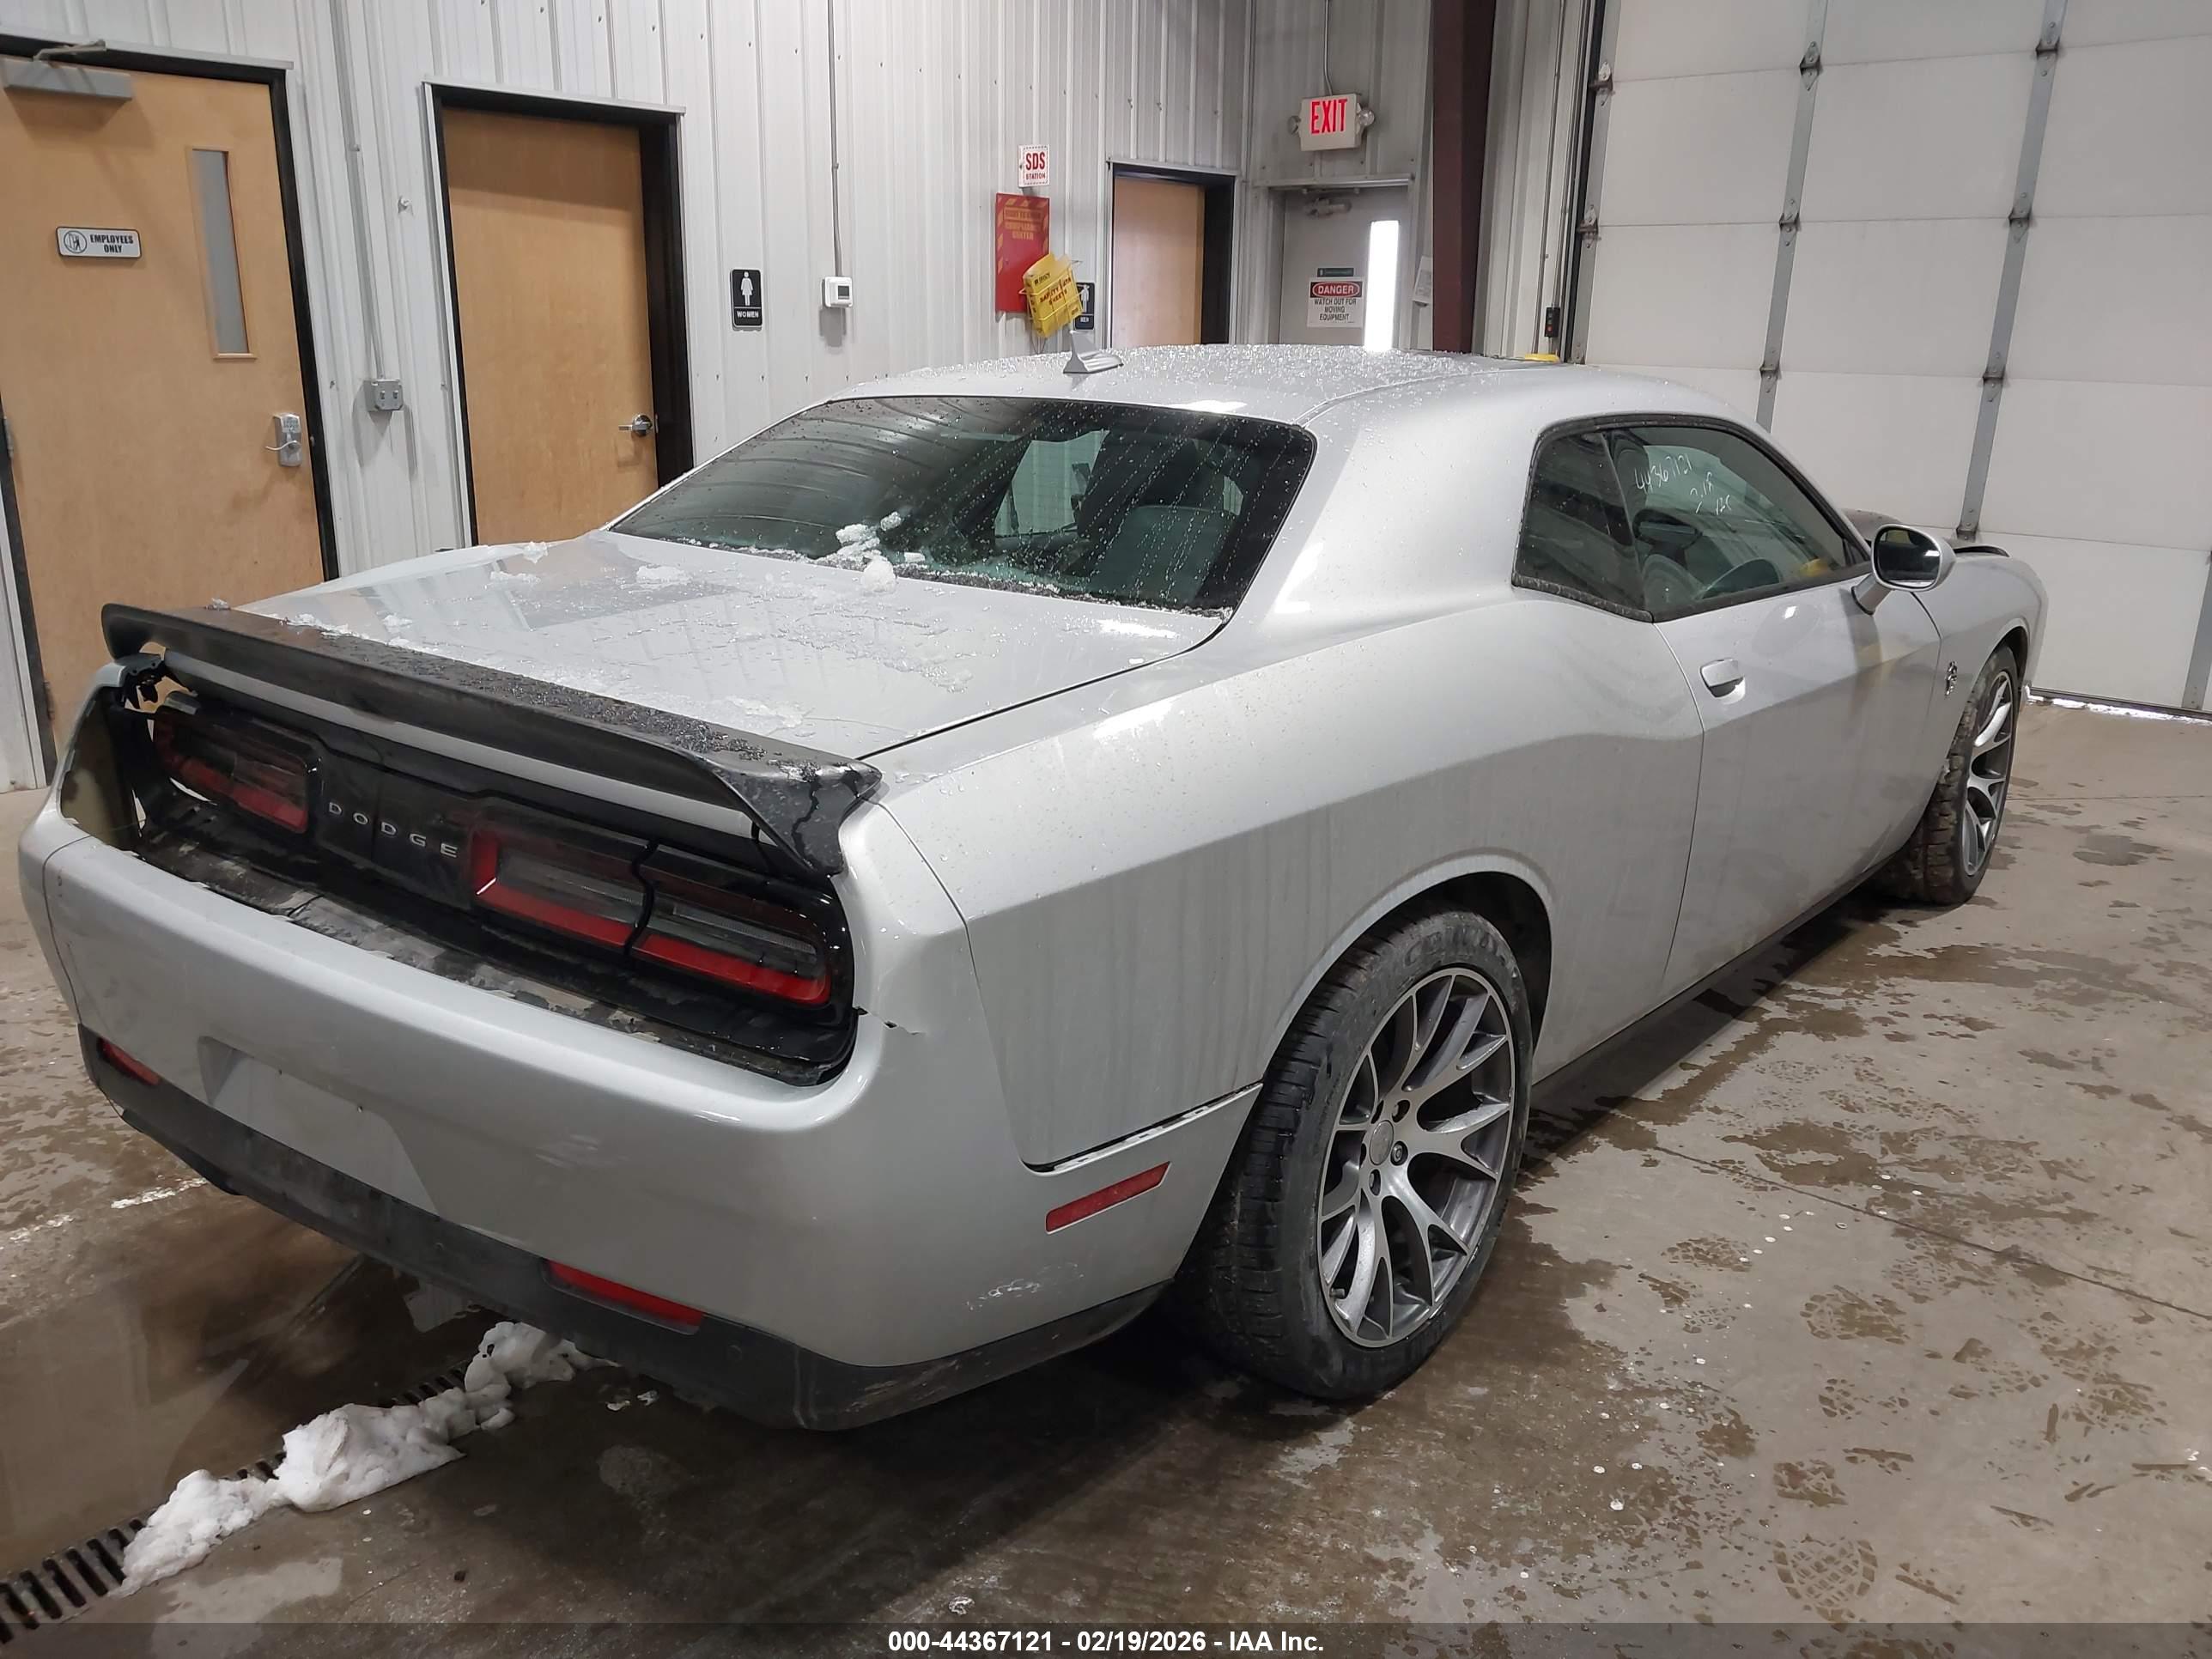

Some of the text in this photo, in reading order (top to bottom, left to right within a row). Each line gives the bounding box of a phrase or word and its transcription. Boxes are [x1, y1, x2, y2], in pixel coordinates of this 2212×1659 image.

[1311, 98, 1347, 134] EXIT
[1025, 151, 1045, 170] SDS
[1025, 172, 1046, 180] STATION
[89, 234, 134, 244] EMPLOYEES
[104, 244, 122, 253] ONLY
[1318, 285, 1354, 295] DANGER
[736, 310, 759, 319] WOMEN
[329, 802, 458, 858] DODGE
